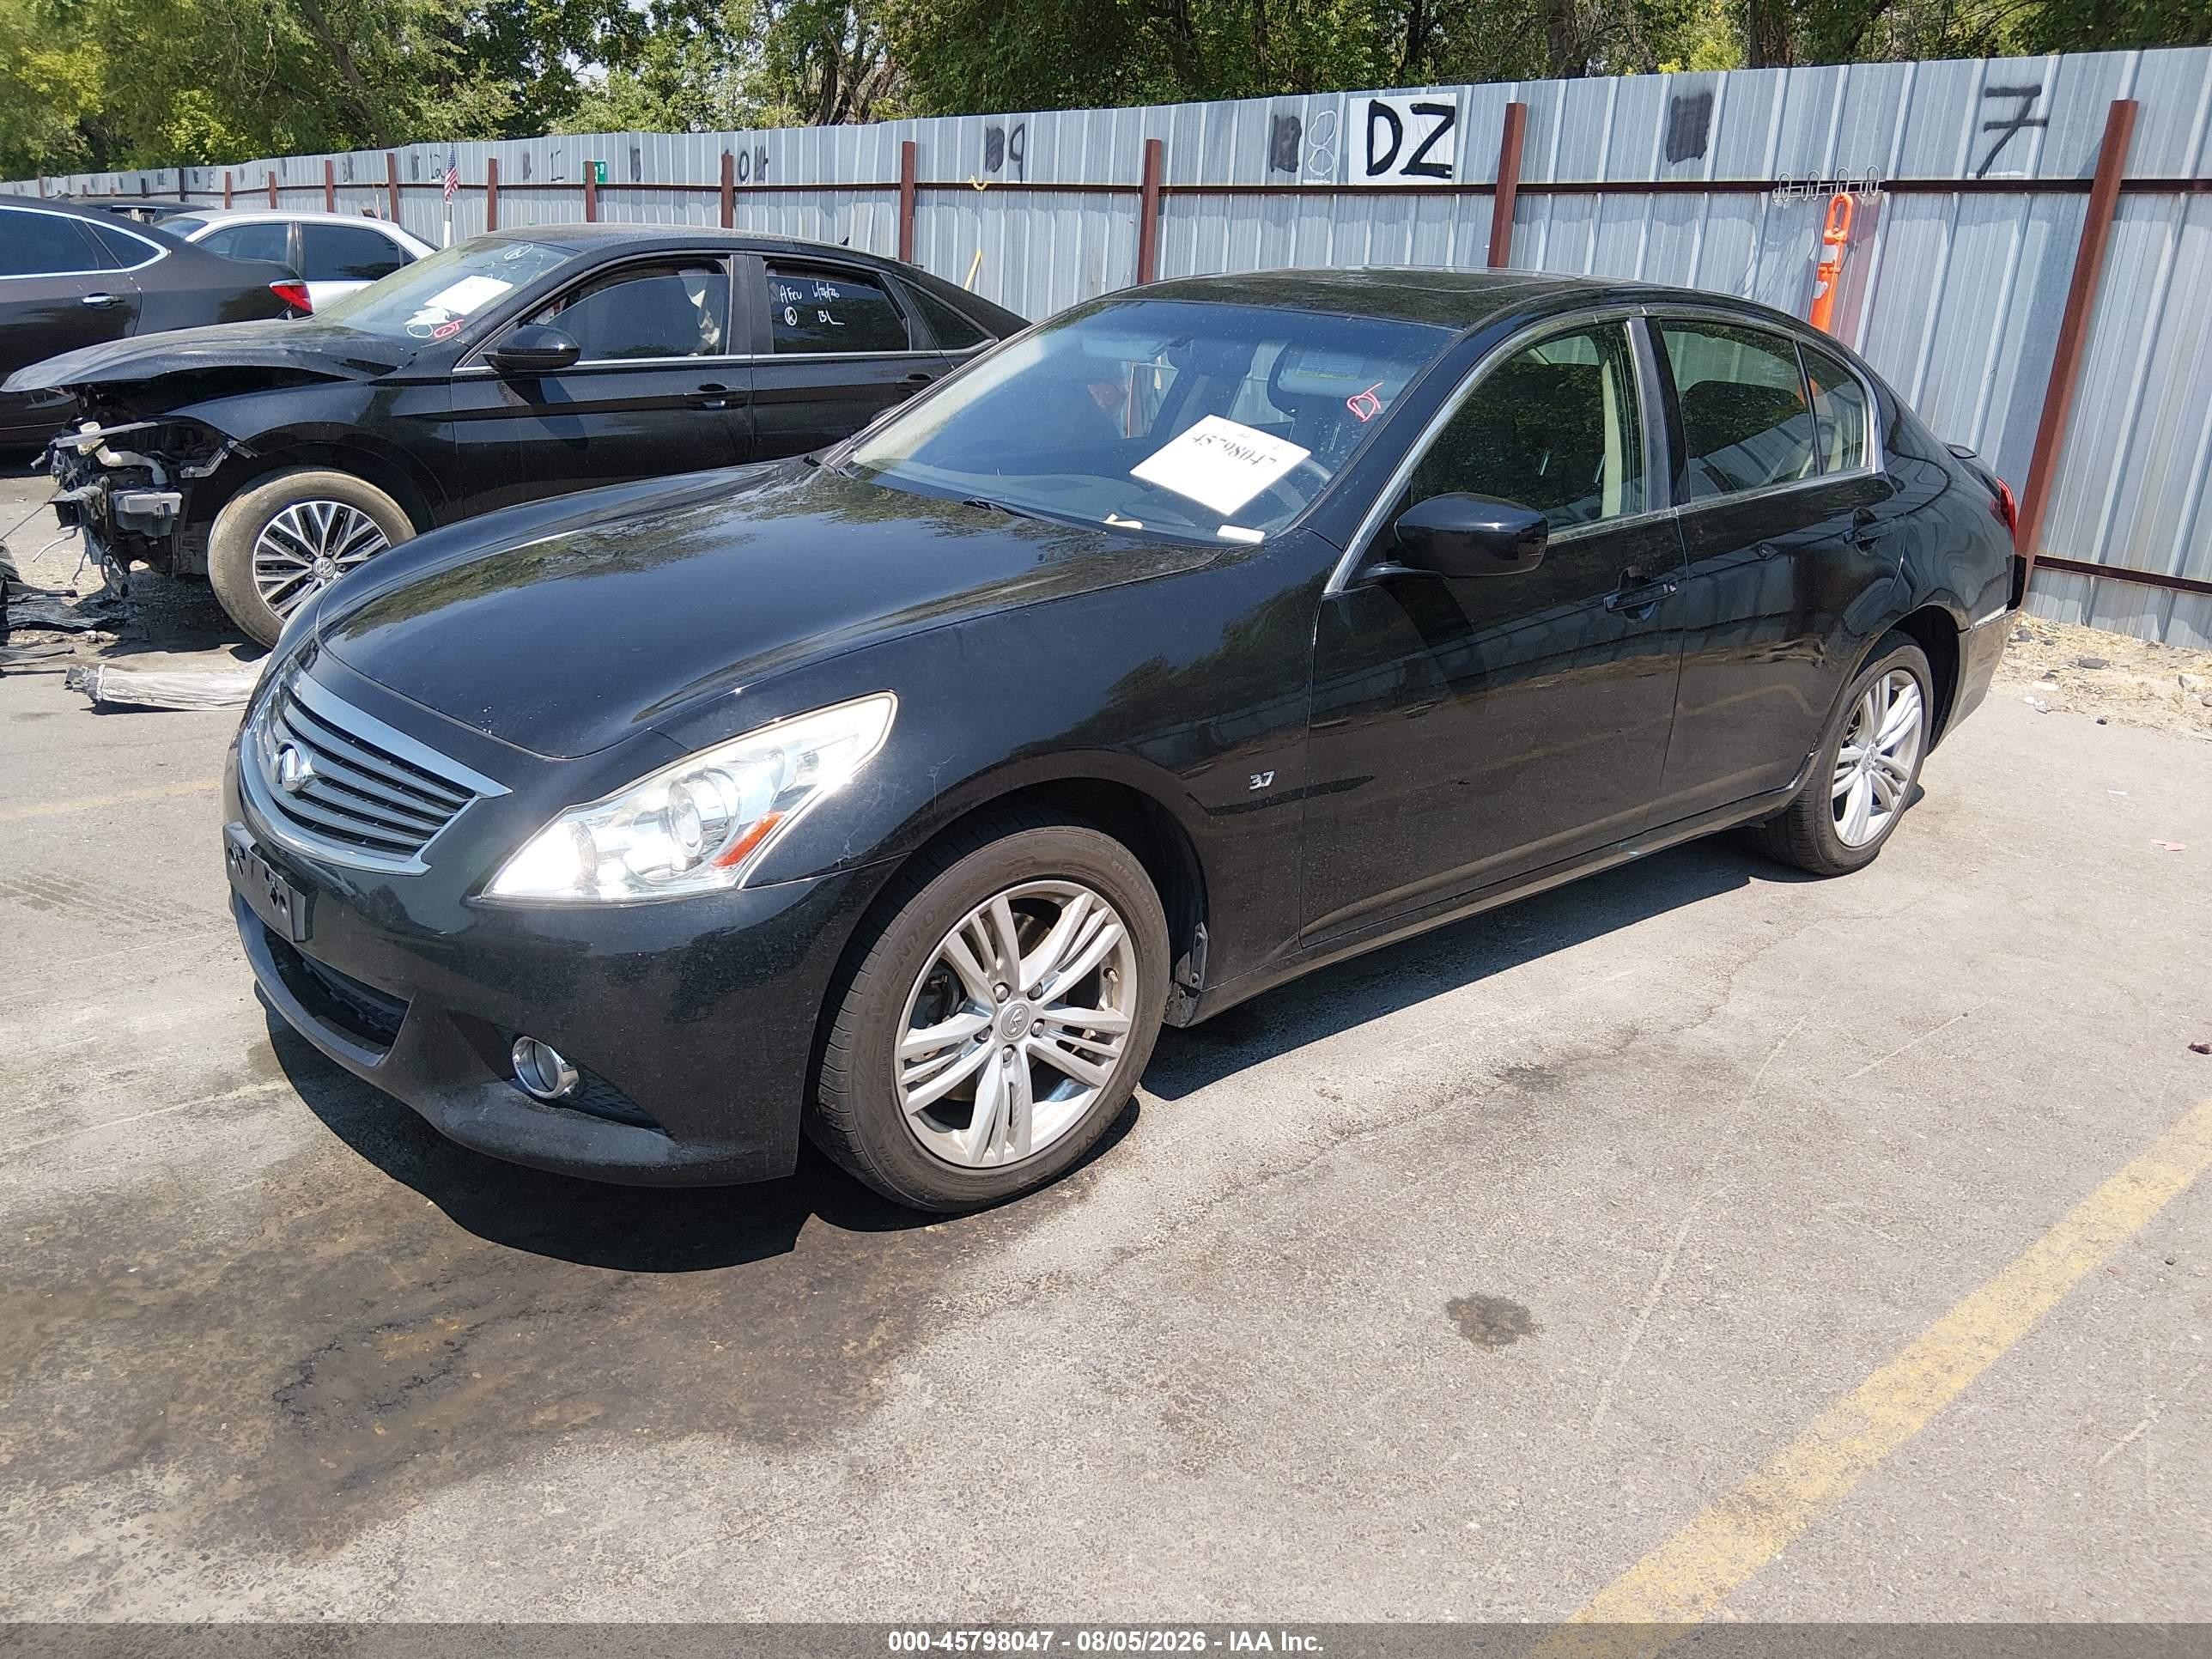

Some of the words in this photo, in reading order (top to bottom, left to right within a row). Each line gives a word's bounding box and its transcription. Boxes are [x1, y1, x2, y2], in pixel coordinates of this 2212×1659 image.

[1308, 110, 1337, 175] 8
[1366, 99, 1455, 178] DZ
[1976, 84, 2050, 179] 7
